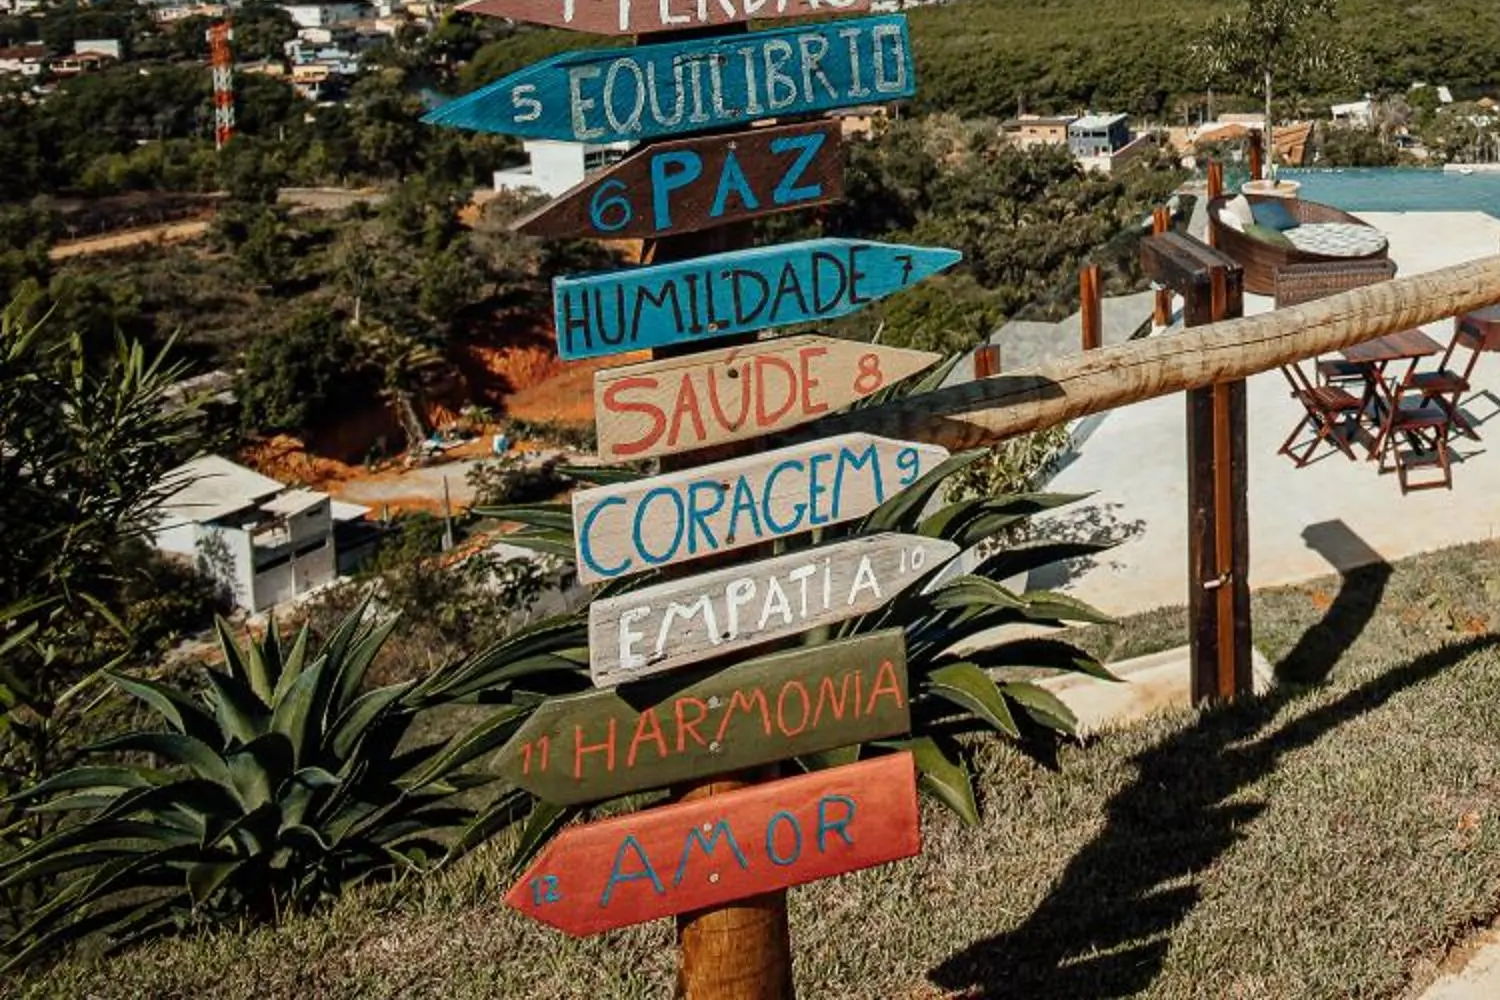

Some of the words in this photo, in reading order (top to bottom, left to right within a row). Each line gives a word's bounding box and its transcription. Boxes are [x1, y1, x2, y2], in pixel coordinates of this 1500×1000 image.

[511, 83, 543, 123] 5
[567, 23, 908, 140] EQUILIBRIO
[589, 179, 633, 232] 6
[650, 132, 827, 231] PAZ
[563, 244, 873, 354] HUMILDADE
[894, 255, 913, 286] 7
[602, 346, 829, 456] SAÚDE
[853, 353, 884, 396] 8
[579, 443, 885, 577] CORAGEM
[896, 447, 921, 485] 9
[618, 554, 882, 669] EMPATIA
[899, 545, 926, 574] 10
[521, 735, 549, 775] 11
[573, 658, 904, 779] HARMONIA
[530, 874, 561, 906] 12
[600, 794, 856, 907] AMOR
